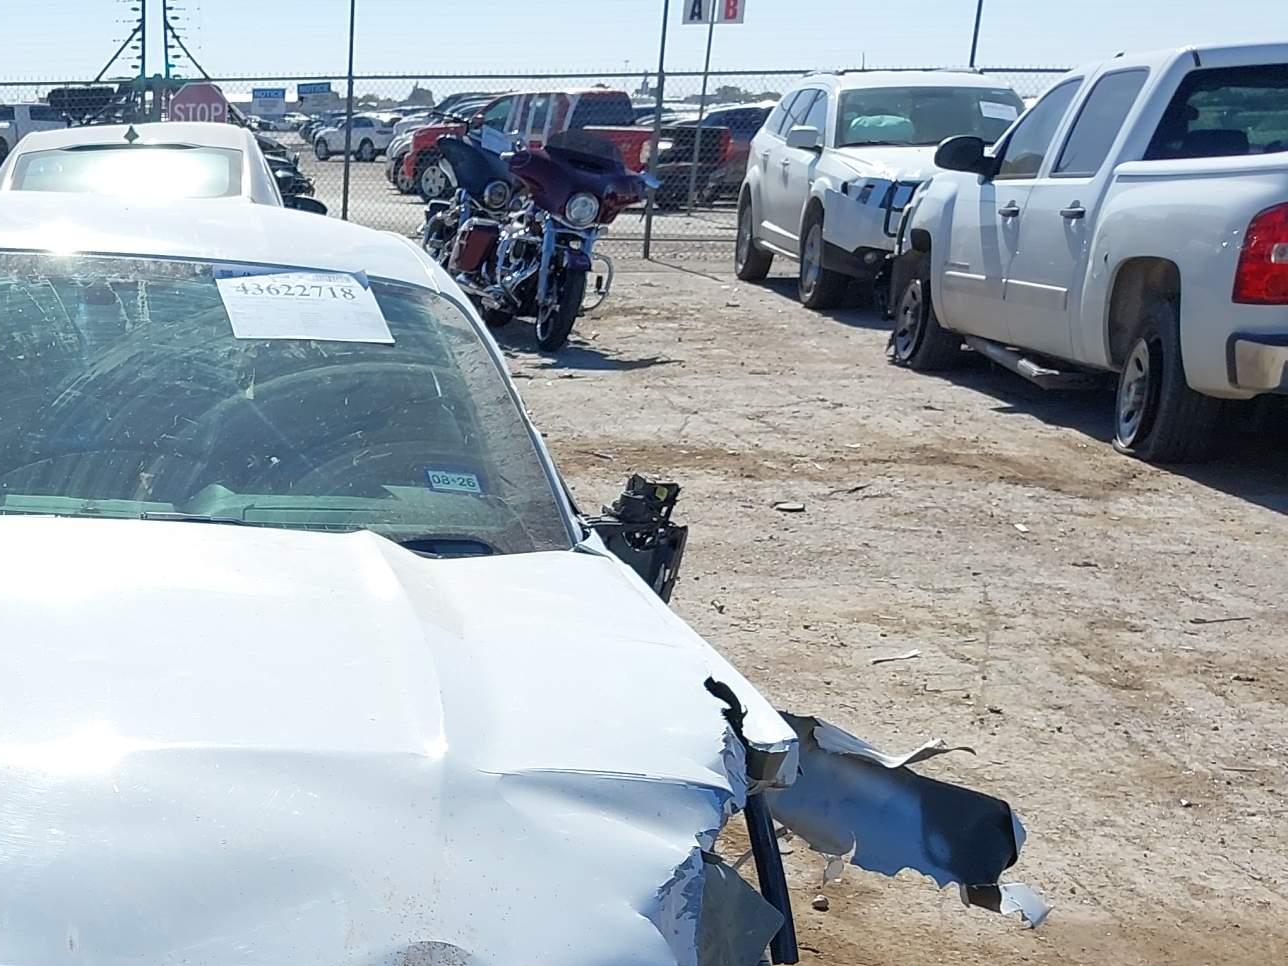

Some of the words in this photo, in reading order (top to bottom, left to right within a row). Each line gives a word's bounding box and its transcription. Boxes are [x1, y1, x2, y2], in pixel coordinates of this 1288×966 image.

[690, 0, 702, 20] A
[724, 0, 738, 20] B
[254, 90, 284, 98] NOTICE
[174, 103, 223, 122] STOP
[233, 281, 357, 301] 43622718
[431, 474, 476, 488] 08-26
